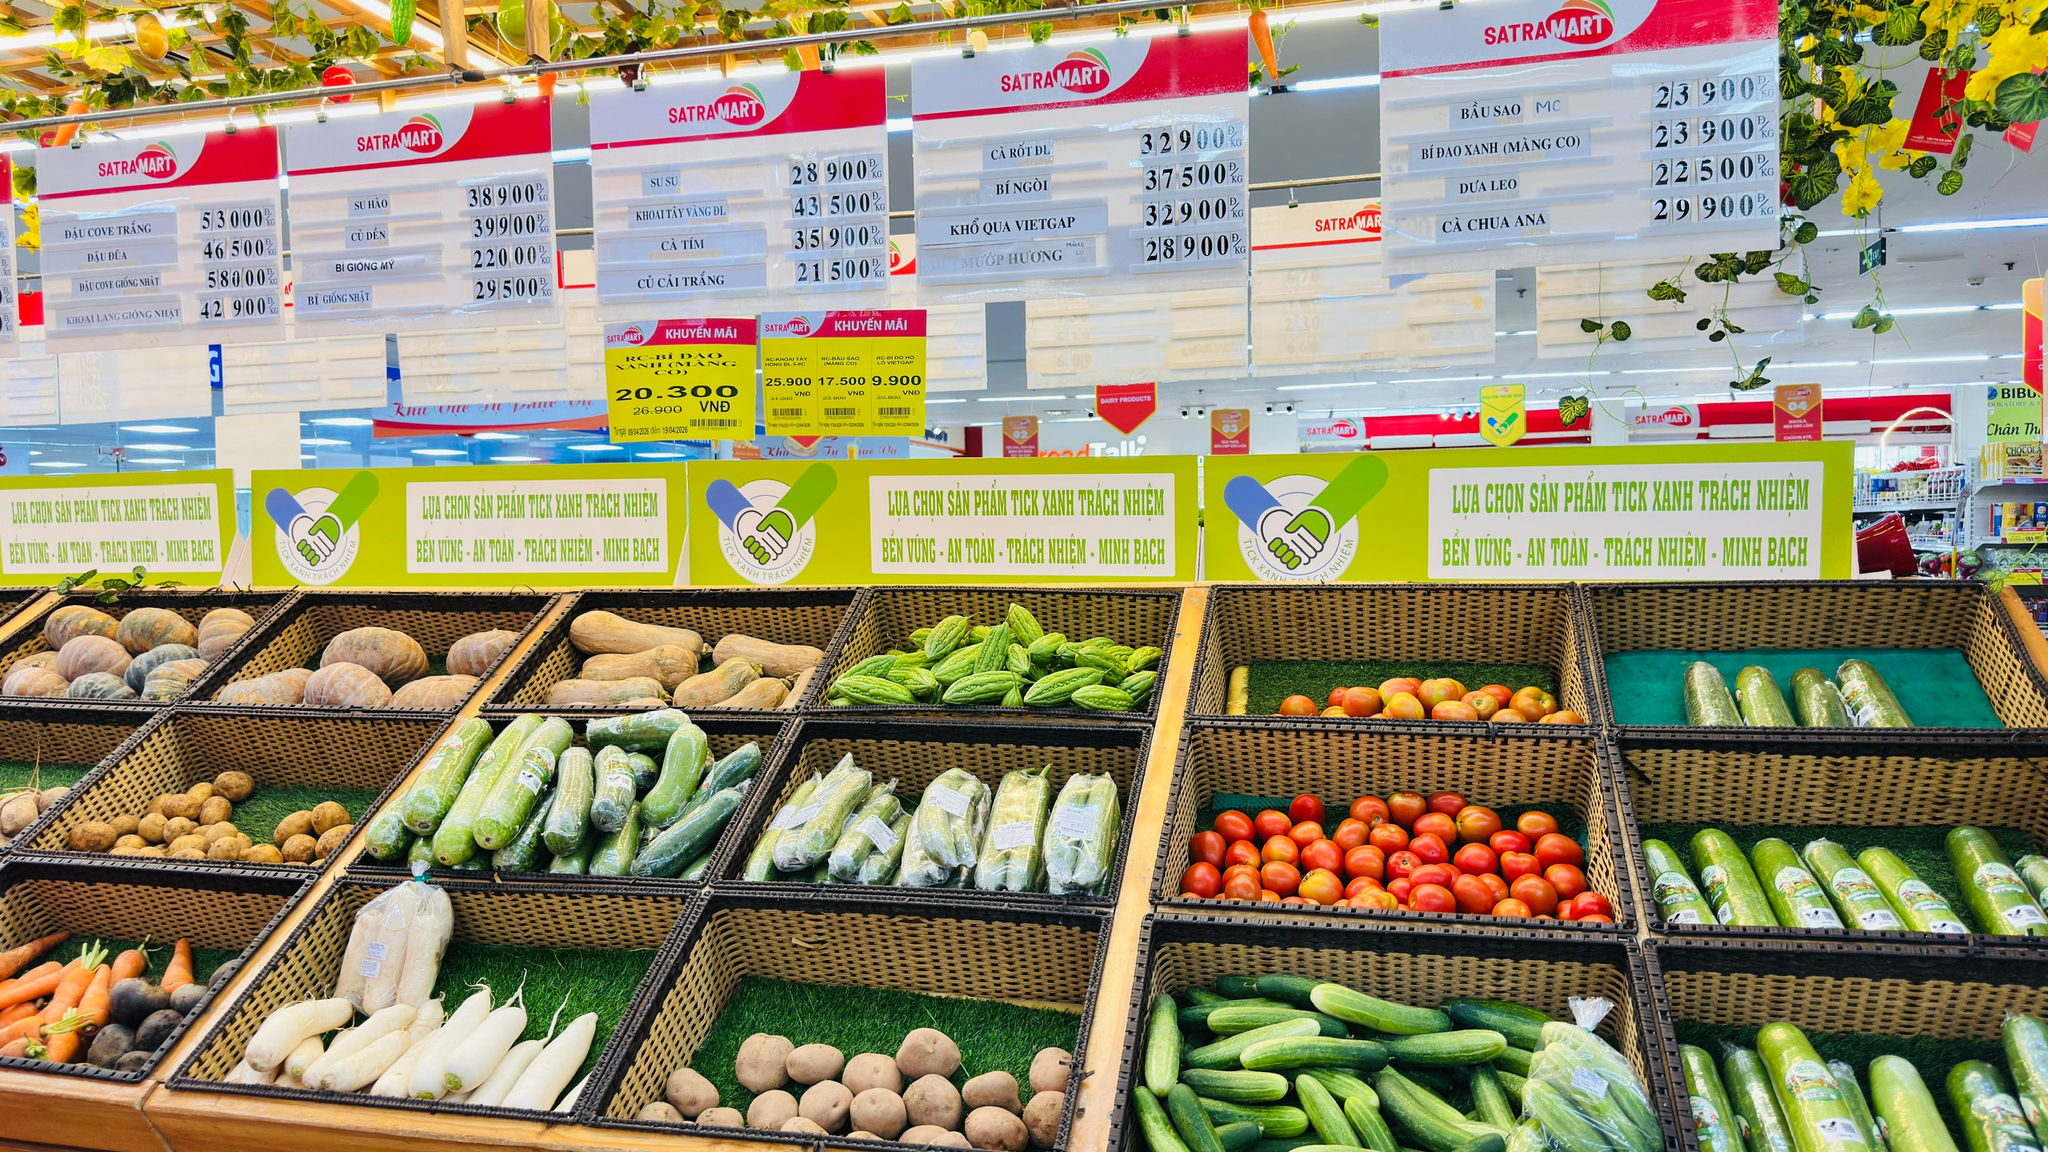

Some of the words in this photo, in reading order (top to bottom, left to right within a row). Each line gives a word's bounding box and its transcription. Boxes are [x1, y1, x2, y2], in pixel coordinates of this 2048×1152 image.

[1484, 14, 1604, 45] SATRAMART
[1001, 65, 1102, 92] SATRAMART
[669, 99, 759, 124] SATRAMART
[1461, 102, 1490, 120] BẦU
[1494, 104, 1520, 118] SAO
[1536, 99, 1561, 114] MC
[357, 128, 437, 151] SATRAMART
[991, 145, 1006, 160] CÀ
[1010, 142, 1032, 158] RỐT
[1035, 144, 1050, 156] ĐL
[1421, 144, 1434, 161] BÍ
[1436, 144, 1461, 158] ĐAO
[1465, 142, 1499, 156] XANH
[1503, 136, 1551, 156] (MÀNG
[1555, 135, 1581, 151] CO)
[98, 155, 174, 177] SATRAMART
[651, 177, 663, 188] SU
[666, 176, 678, 186] SU
[996, 180, 1010, 195] BÍ
[1013, 177, 1048, 193] NGÒI
[1459, 179, 1486, 194] DƯA
[1490, 179, 1517, 192] LEO
[354, 199, 366, 210] SU
[368, 195, 388, 209] HÀO
[636, 209, 664, 221] KHOAI
[666, 206, 684, 219] TÂY
[686, 204, 711, 218] VÀNG
[713, 204, 726, 216] ĐL
[64, 226, 85, 240] ĐẬU
[86, 226, 115, 238] COVE
[117, 220, 151, 235] TRẮNG
[951, 218, 979, 236] KHỔ
[983, 221, 1010, 235] QUA
[1015, 217, 1076, 232] VIETGAP
[1442, 216, 1462, 234] CÀ
[1467, 216, 1510, 230] CHUA
[1515, 213, 1546, 227] ANA
[351, 228, 364, 241] CỦ
[661, 237, 677, 251] CÀ
[680, 236, 704, 250] TÍM
[87, 250, 106, 265] ĐẬU
[108, 250, 127, 262] ĐŨA
[1008, 249, 1062, 265] HƯƠNG
[79, 279, 96, 293] ĐẬU
[96, 280, 115, 292] COVE
[114, 275, 138, 291] GIỐNG
[139, 276, 160, 289] NHẬT
[637, 276, 655, 289] CỦ
[657, 274, 680, 287] CẢI
[683, 270, 724, 286] TRẮNG
[308, 292, 318, 305] BÍ
[322, 289, 347, 304] GIỐNG
[348, 289, 370, 302] NHẬT
[66, 314, 95, 326] KHOAI
[96, 312, 120, 324] LANG
[154, 308, 180, 320] NHẬT
[835, 317, 883, 331] KHUYẾN
[885, 318, 907, 330] MÃI
[666, 324, 711, 339] KHUYẾN
[714, 326, 737, 338] MÃI
[765, 323, 808, 332] SATRAMART
[607, 332, 642, 343] SATRAMART
[616, 362, 662, 370] XANH
[766, 377, 812, 386] 25.900
[818, 377, 866, 386] 17.500
[872, 375, 921, 386] 9.900
[616, 385, 738, 401] 20.300
[2002, 388, 2040, 398] BIBU
[633, 405, 682, 415] 26.900
[700, 401, 730, 413] VNĐ
[1987, 423, 2019, 436] Chân
[1453, 484, 1480, 520] LỰA
[1486, 482, 1524, 519] CHỌN
[1530, 475, 1559, 512] SẢN
[1565, 471, 1607, 512] PHẨM
[1612, 480, 1648, 512] TICK
[1653, 480, 1693, 511] XANH
[1699, 472, 1751, 511] TRÁCH
[1757, 471, 1809, 517] NHIỆM
[422, 494, 441, 524] LỰA
[444, 494, 470, 524] CHỌN
[474, 488, 493, 519] SẢN
[497, 485, 525, 519] PHẨM
[528, 494, 552, 519] TICK
[555, 494, 582, 518] XANH
[586, 487, 620, 518] TRÁCH
[624, 487, 658, 523] NHIỆM
[416, 531, 434, 562] BỀN
[438, 534, 463, 562] VỮNG
[473, 539, 485, 562] AN
[489, 532, 514, 562] TOÀN
[524, 531, 557, 562] TRÁCH
[560, 532, 592, 566] NHIỆM
[603, 538, 629, 561] MINH
[633, 538, 659, 566] BẠCH
[1443, 529, 1470, 566] BỀN
[1475, 532, 1512, 566] VỮNG
[1527, 538, 1546, 566] AN
[1551, 530, 1589, 566] TOÀN
[1604, 530, 1653, 566] TRÁCH
[1658, 530, 1706, 572] NHIỆM
[1723, 537, 1762, 566] MINH
[1768, 535, 1808, 572] BẠCH
